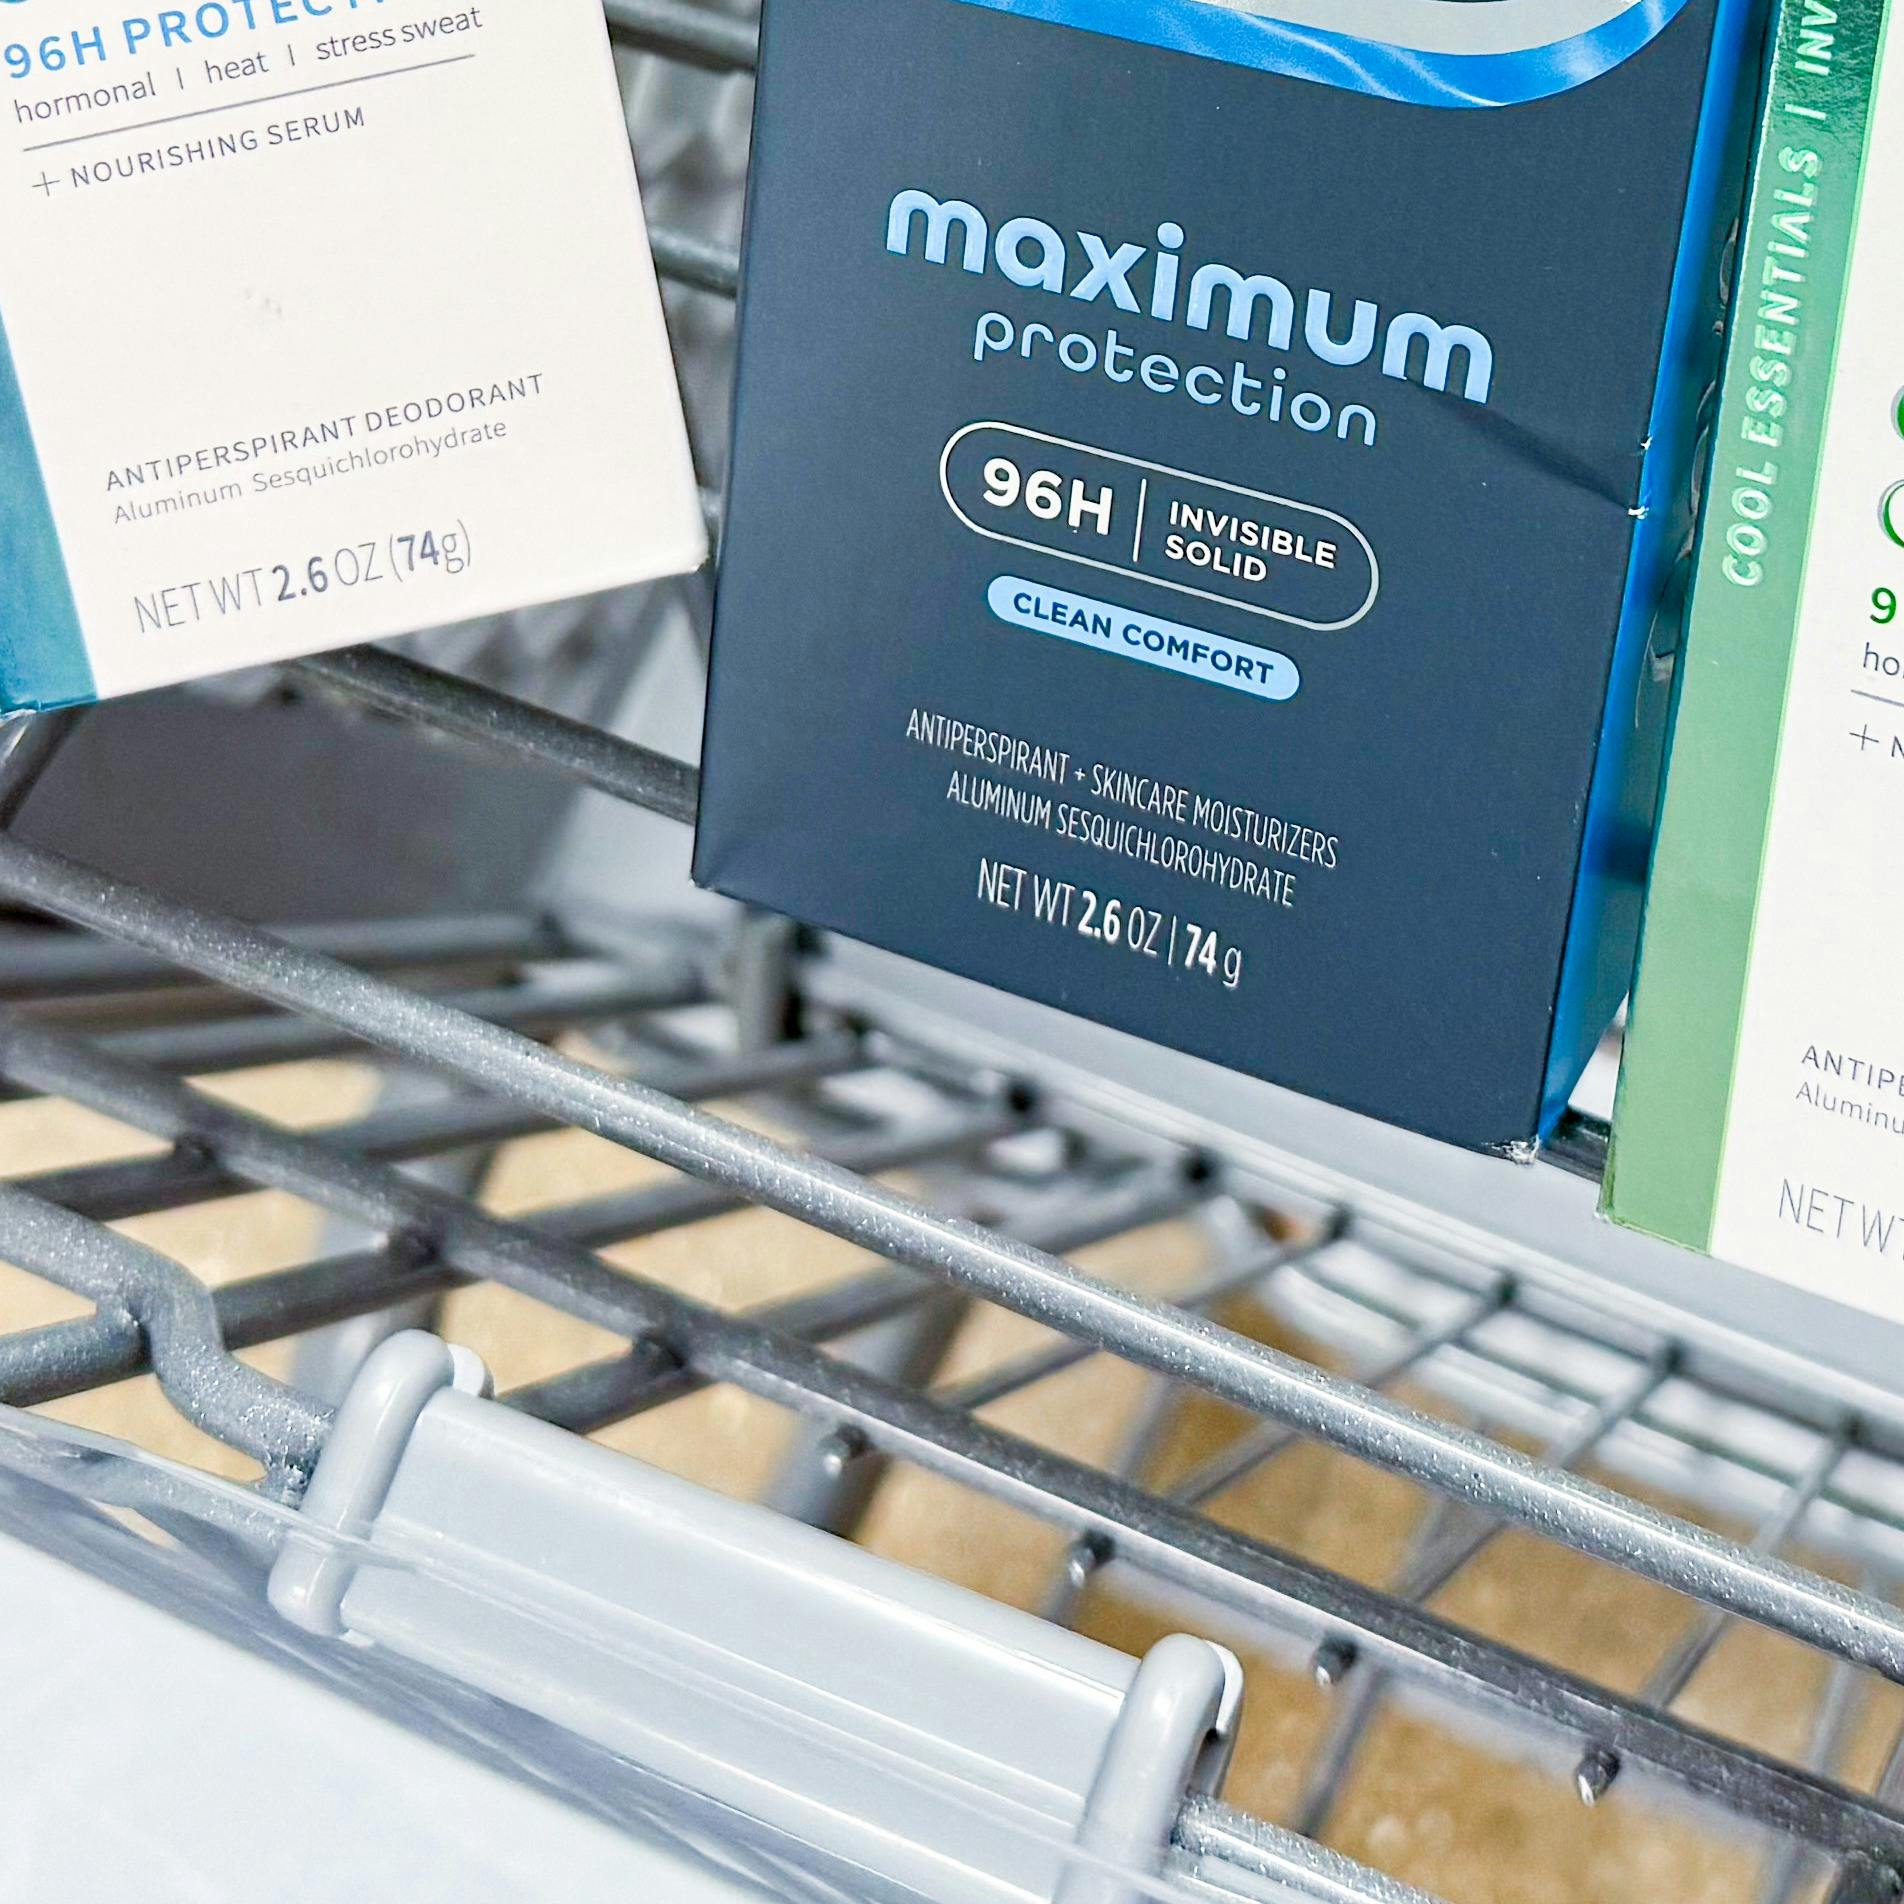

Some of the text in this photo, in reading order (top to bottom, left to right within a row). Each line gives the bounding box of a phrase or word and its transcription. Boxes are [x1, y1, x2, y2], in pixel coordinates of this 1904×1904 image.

[4, 27, 106, 79] 96H
[14, 5, 483, 124] hormonal heat stress sweat
[71, 129, 259, 190] NOURISHING
[267, 106, 366, 148] SERUM
[885, 188, 1493, 404] maximum
[1741, 143, 1820, 447] ESSENTIALS
[106, 372, 545, 492] ANTIPERSPIRANT DEODORANT
[972, 311, 1378, 446] protection
[114, 418, 508, 525] Aluminum Sesquichlorohydrate
[981, 457, 1336, 569] 96H INVISIBLE
[1722, 458, 1779, 589] COOL
[134, 518, 472, 633] NET WT 2.6 OZ (74g)
[1165, 534, 1268, 583] SOLID
[1012, 591, 1275, 685] CLEAN COMFORT
[906, 708, 1070, 785] ANTIPERSPIRANT
[1091, 763, 1190, 822] SKINCARE
[1193, 795, 1340, 869] MOISTURIZERS
[947, 770, 1297, 908] ALUMINUM SESQUICHLOROHYDRATE
[977, 858, 1027, 911] NET
[1032, 874, 1076, 927] WT
[1077, 890, 1121, 945] 2.6
[1127, 907, 1161, 959] OZ
[1183, 924, 1219, 976] 74
[1778, 1178, 1855, 1239] NET
